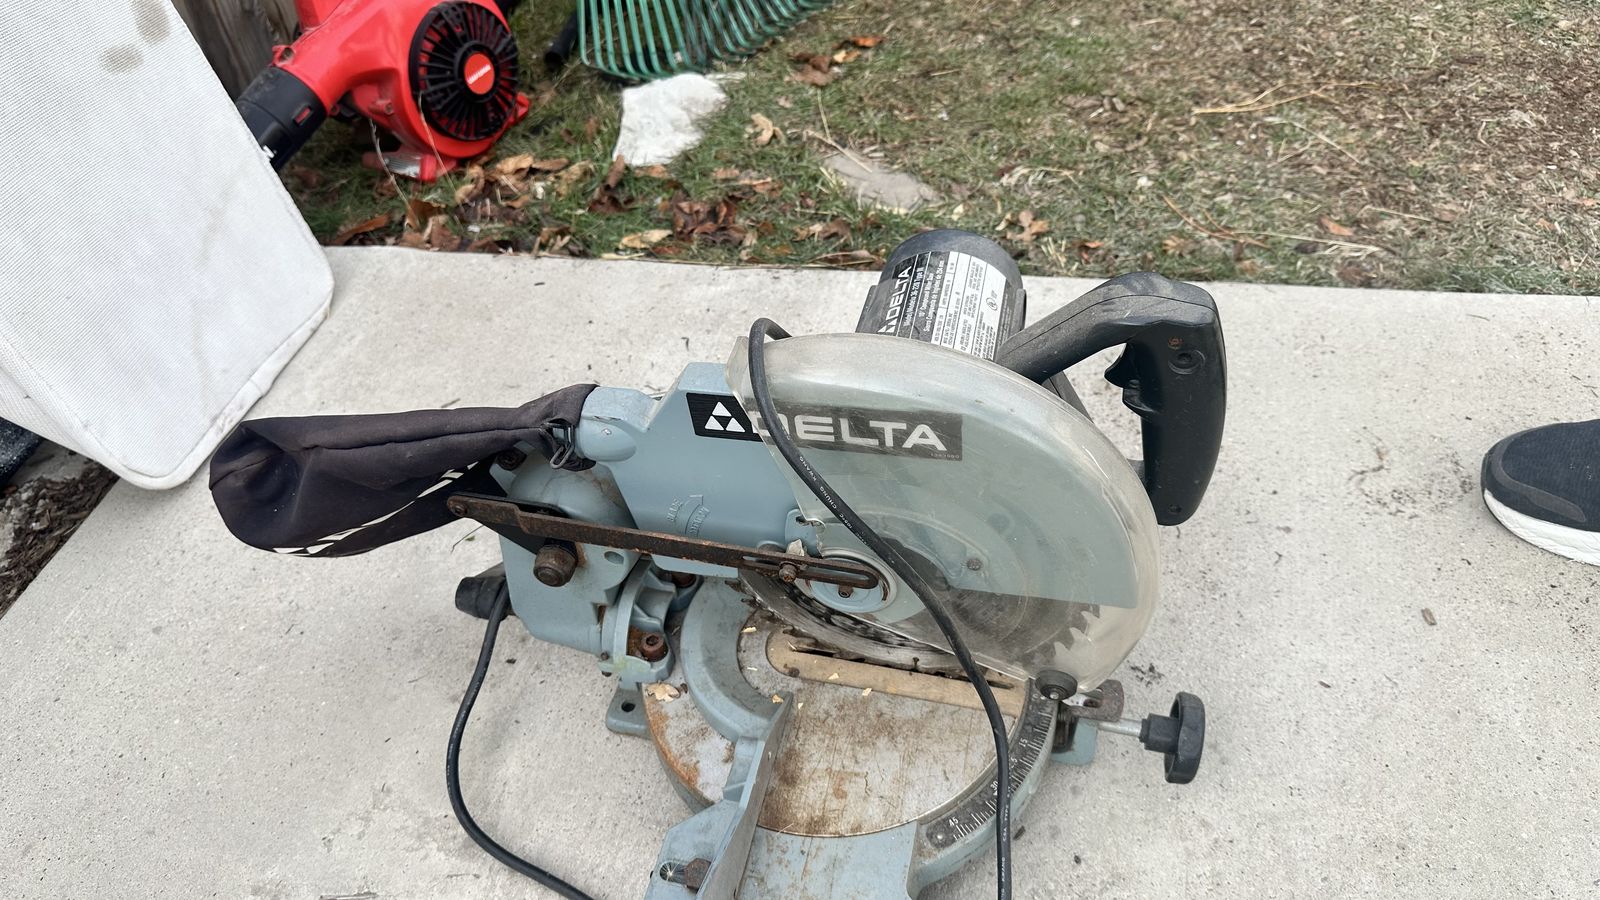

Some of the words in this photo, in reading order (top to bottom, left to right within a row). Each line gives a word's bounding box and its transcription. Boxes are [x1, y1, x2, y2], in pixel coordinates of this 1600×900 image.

[886, 266, 912, 320] DELTA
[749, 411, 947, 451] DELTA
[800, 456, 817, 481] KWANG
[820, 486, 837, 509] CHUNG
[1019, 738, 1028, 747] 15
[990, 781, 999, 791] 30
[948, 816, 959, 827] 45
